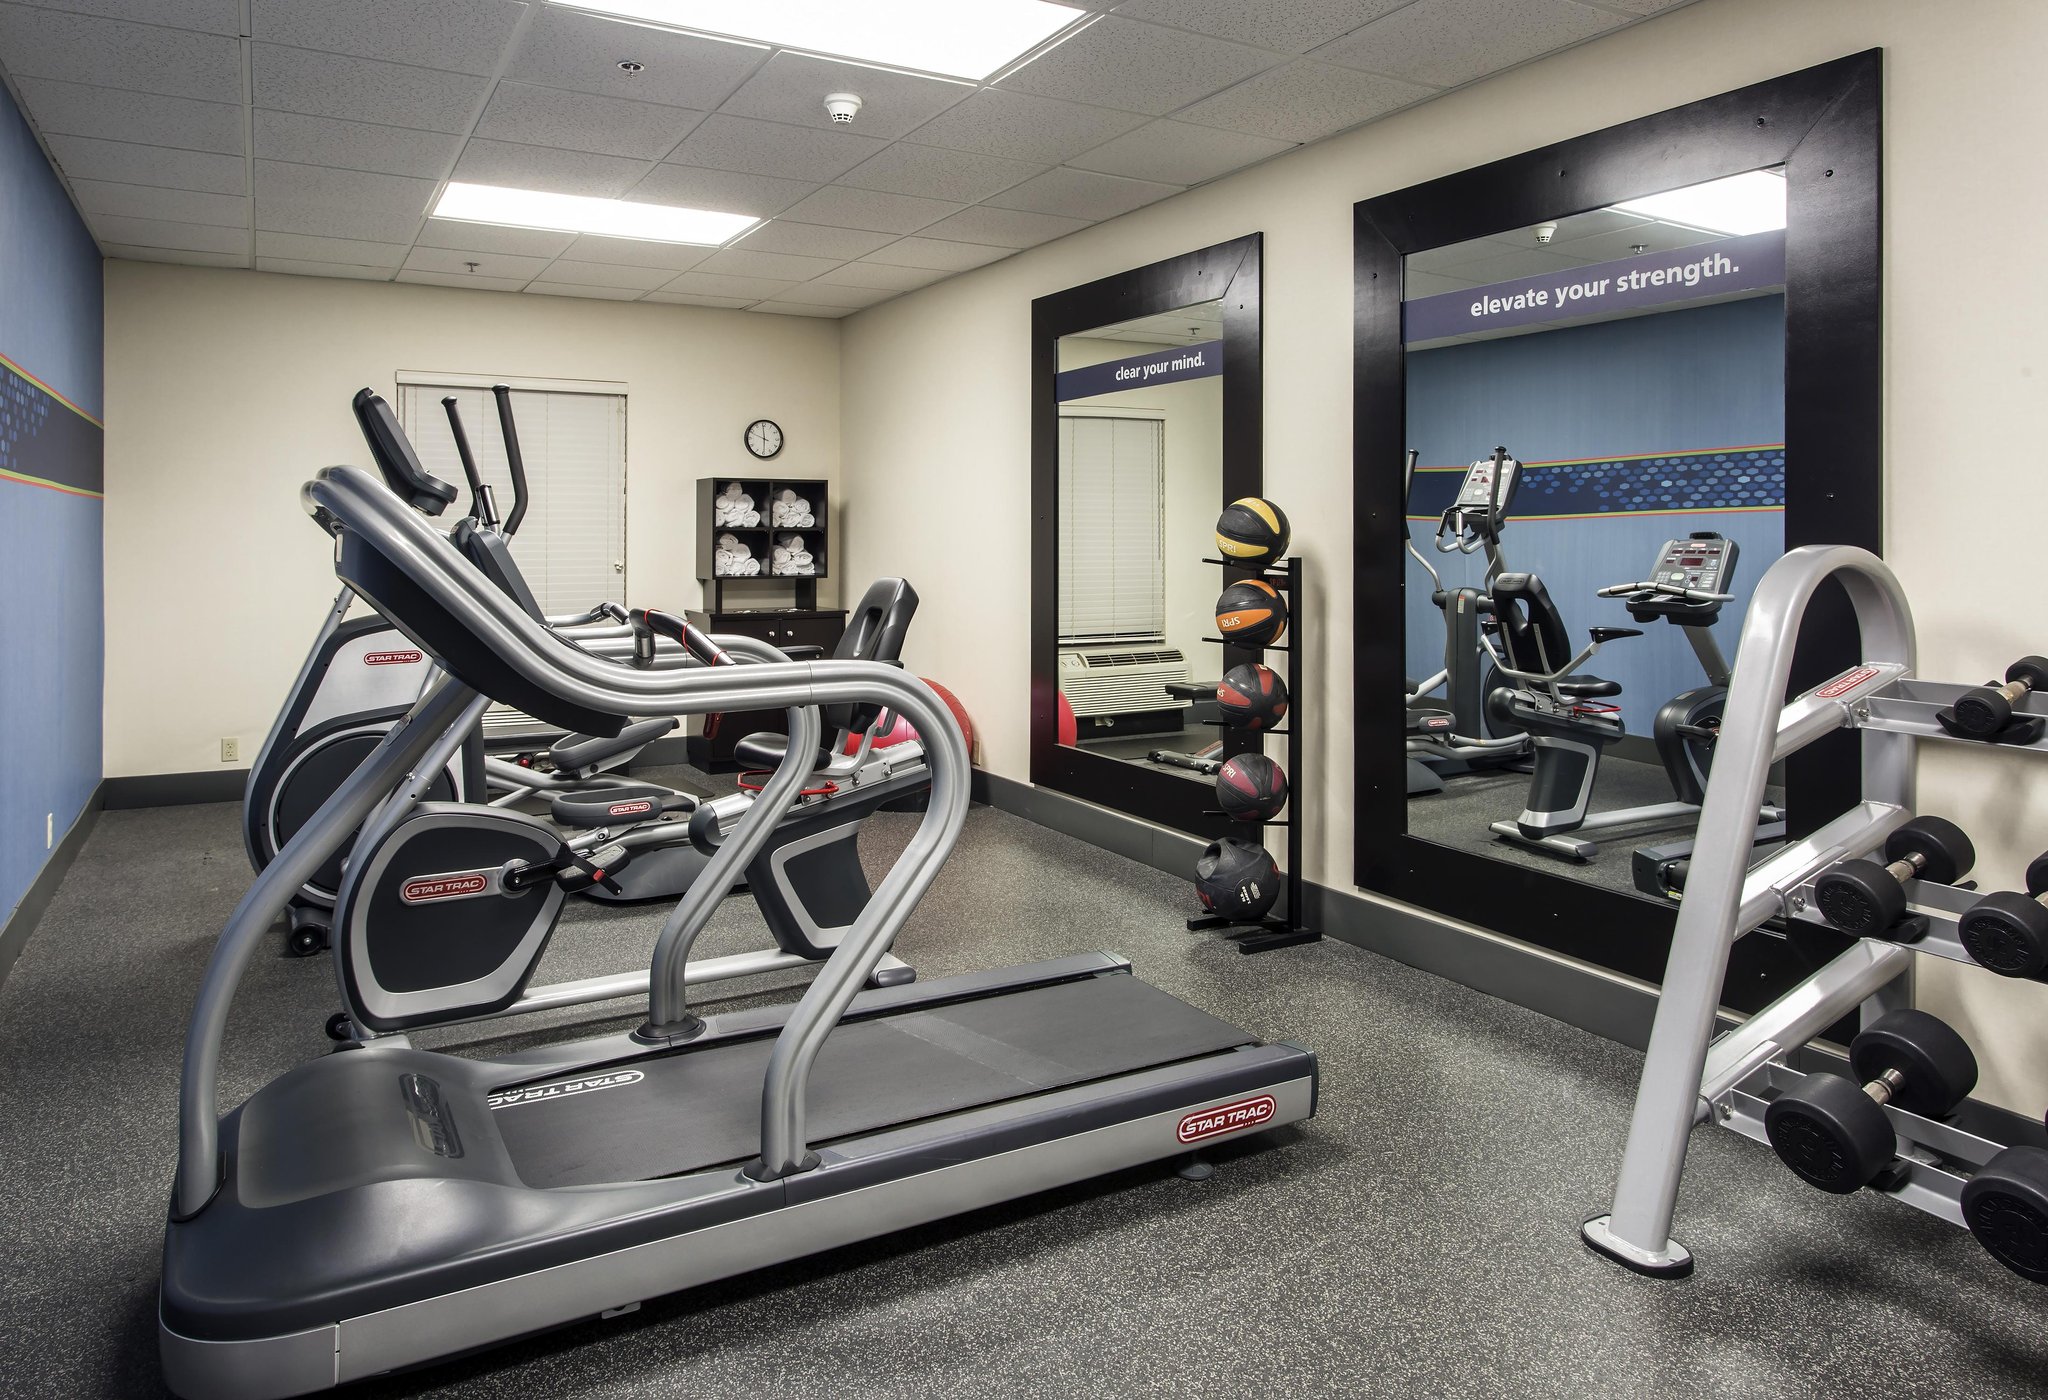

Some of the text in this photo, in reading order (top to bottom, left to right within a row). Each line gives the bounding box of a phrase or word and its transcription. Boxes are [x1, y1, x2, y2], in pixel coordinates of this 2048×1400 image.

[1470, 253, 1739, 317] elevate your strength.
[1115, 351, 1205, 381] clear your mind.
[1219, 540, 1236, 553] SPRI
[1221, 616, 1241, 628] SPRI
[1222, 763, 1237, 779] SPRI
[411, 880, 480, 895] STAR TRAC
[487, 1074, 634, 1106] STAR TRAC
[1185, 1103, 1268, 1134] STAR TRAC
